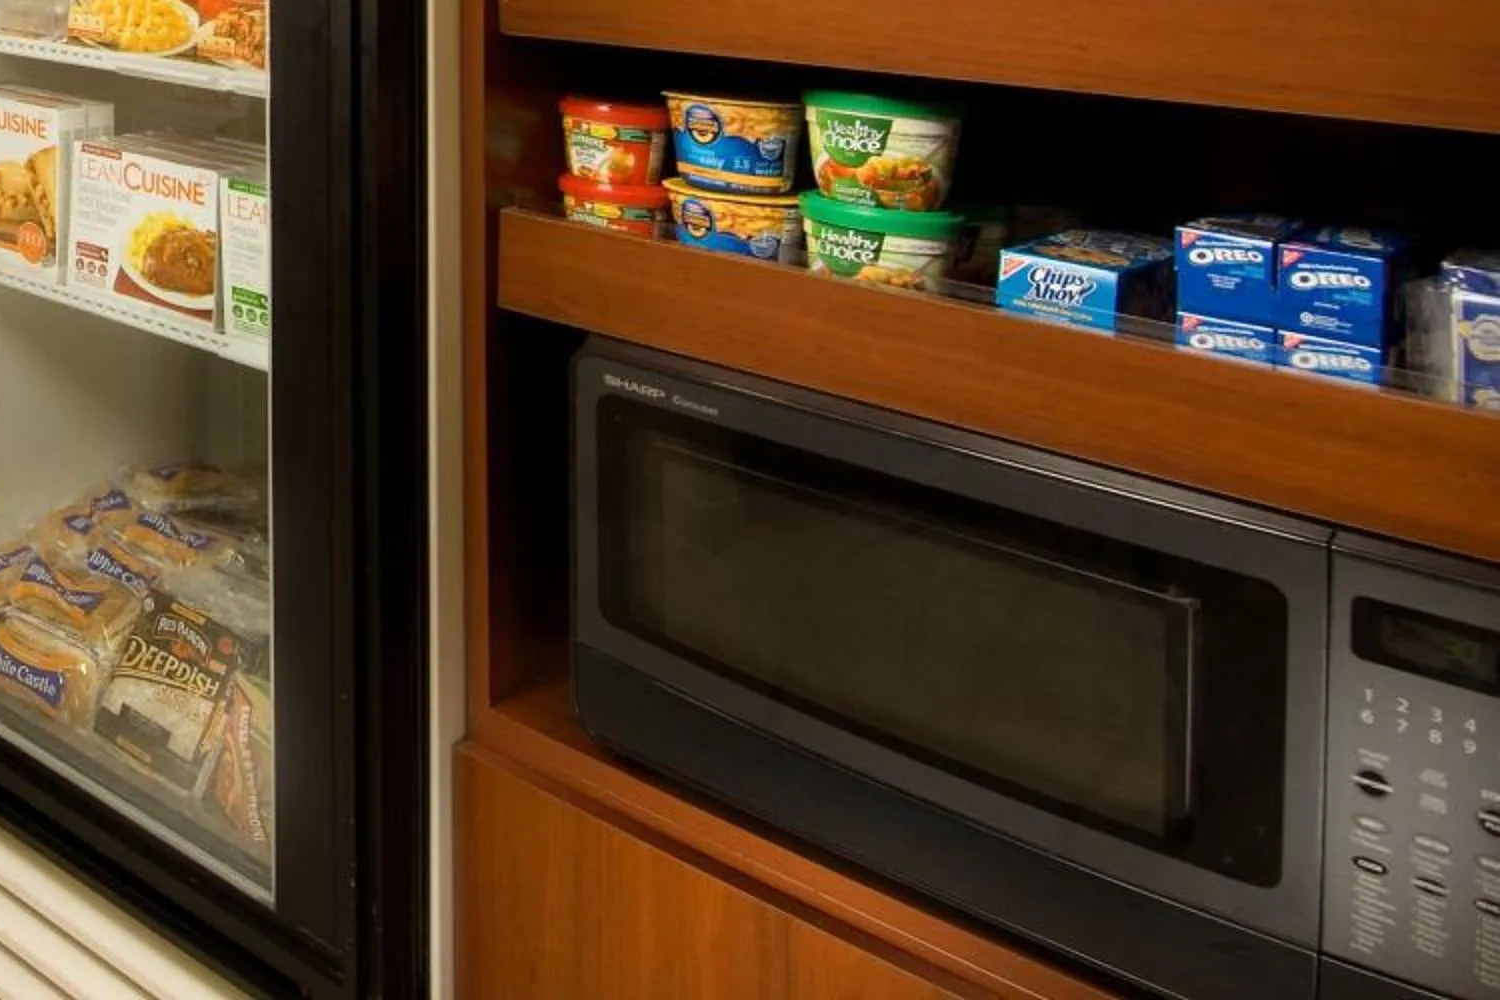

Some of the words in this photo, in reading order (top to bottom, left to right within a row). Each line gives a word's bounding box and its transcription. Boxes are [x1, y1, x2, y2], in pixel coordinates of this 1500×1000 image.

[123, 161, 206, 207] CUISINE
[1189, 247, 1264, 266] OREO
[1029, 265, 1087, 289] Chips
[1290, 270, 1373, 291] OREO
